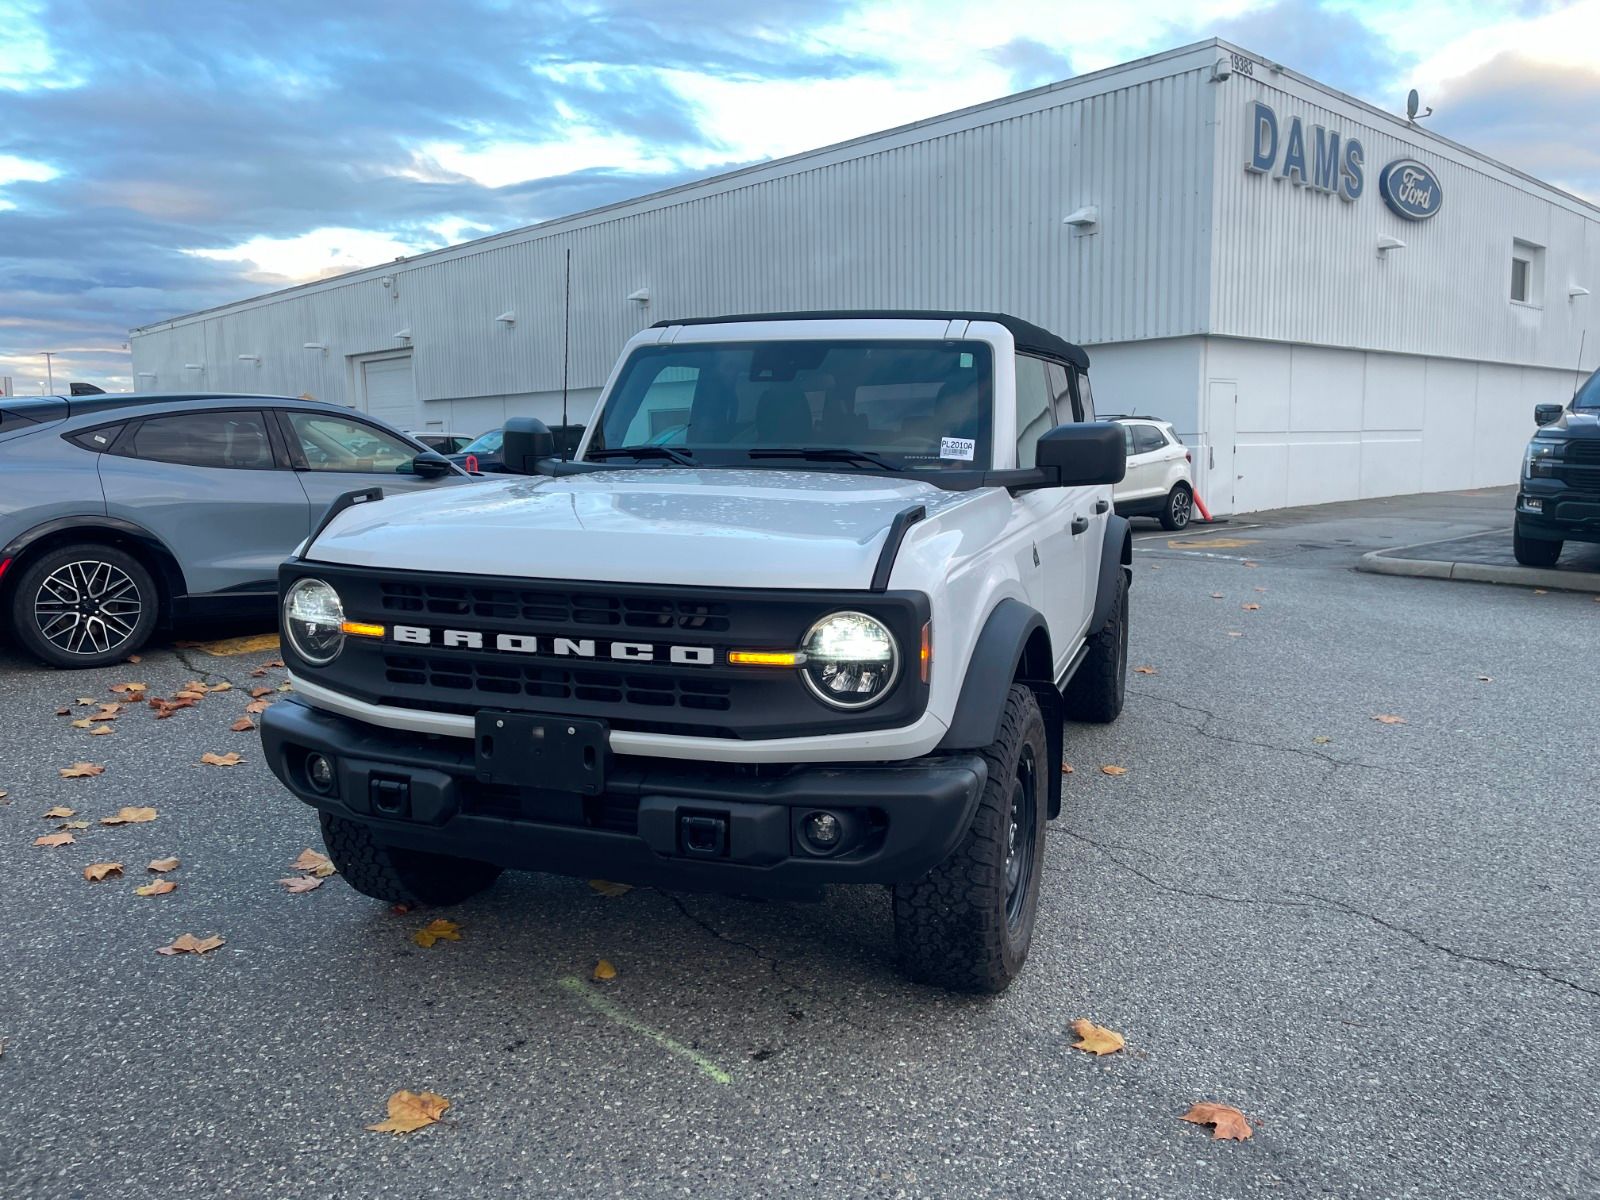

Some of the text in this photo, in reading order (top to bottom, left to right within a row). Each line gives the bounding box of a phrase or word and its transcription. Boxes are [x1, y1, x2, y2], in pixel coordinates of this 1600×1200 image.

[1230, 54, 1253, 76] 19383
[1246, 100, 1364, 200] DAMS
[1399, 168, 1432, 209] Ford
[941, 440, 973, 450] PL2010A
[393, 624, 715, 665] BRONCO
